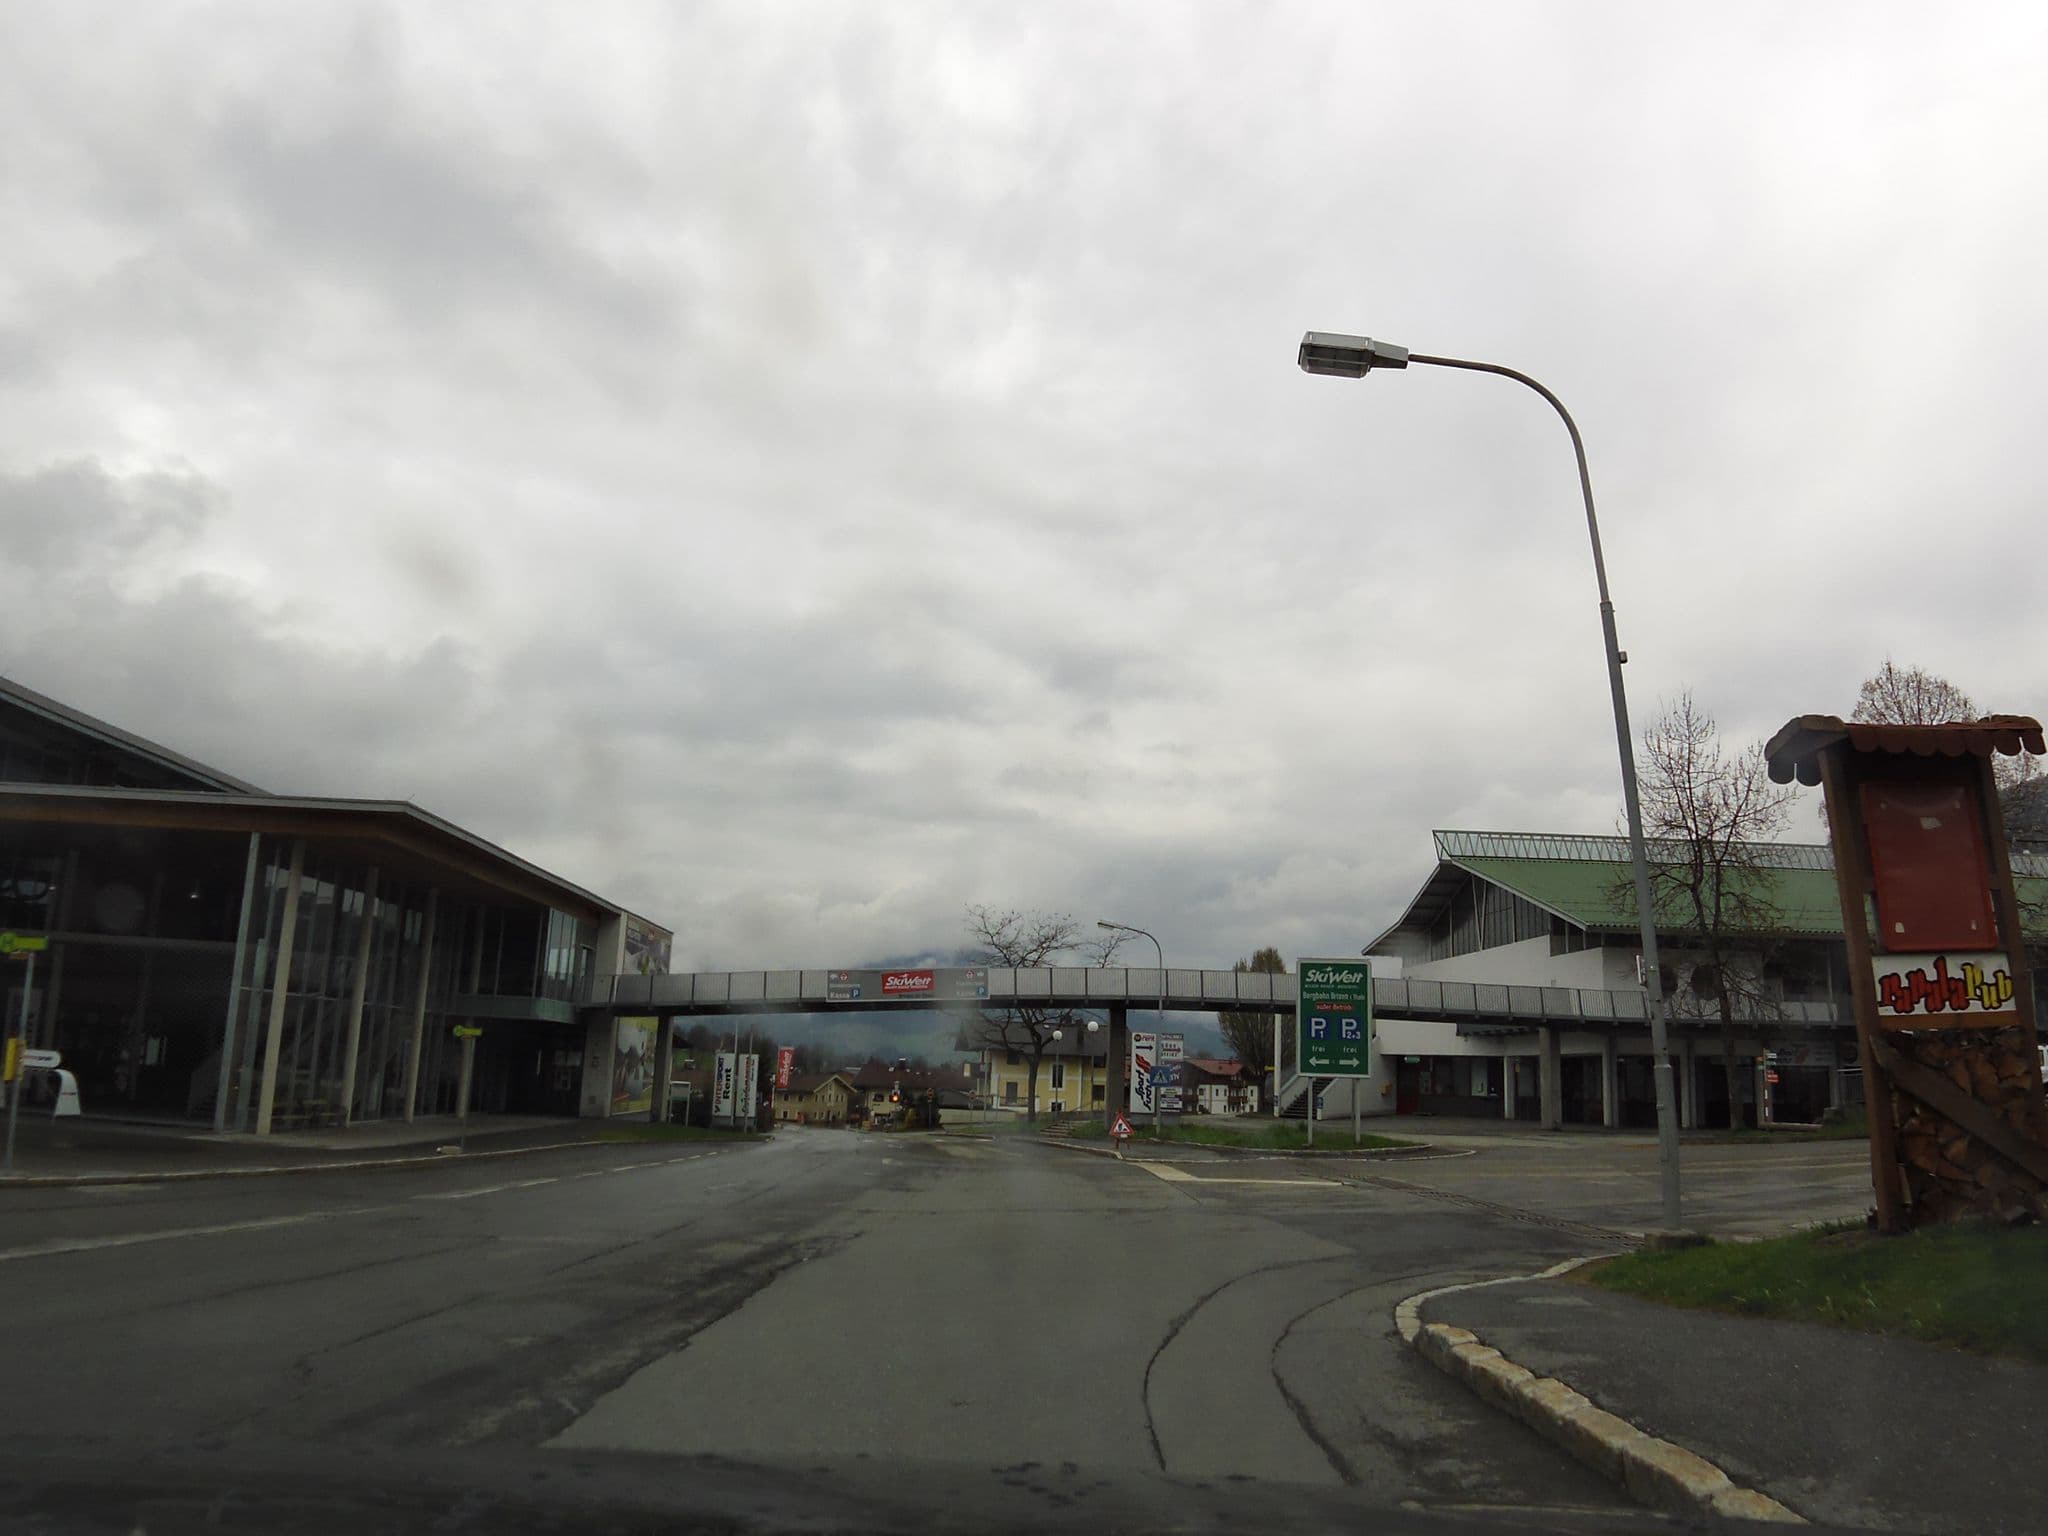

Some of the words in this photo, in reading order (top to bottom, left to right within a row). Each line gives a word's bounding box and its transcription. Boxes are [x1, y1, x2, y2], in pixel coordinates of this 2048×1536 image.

[885, 974, 932, 986] SkiWelt
[1305, 967, 1364, 985] SkiWelt
[1962, 963, 2014, 1010] Pub
[723, 1067, 732, 1099] Rent
